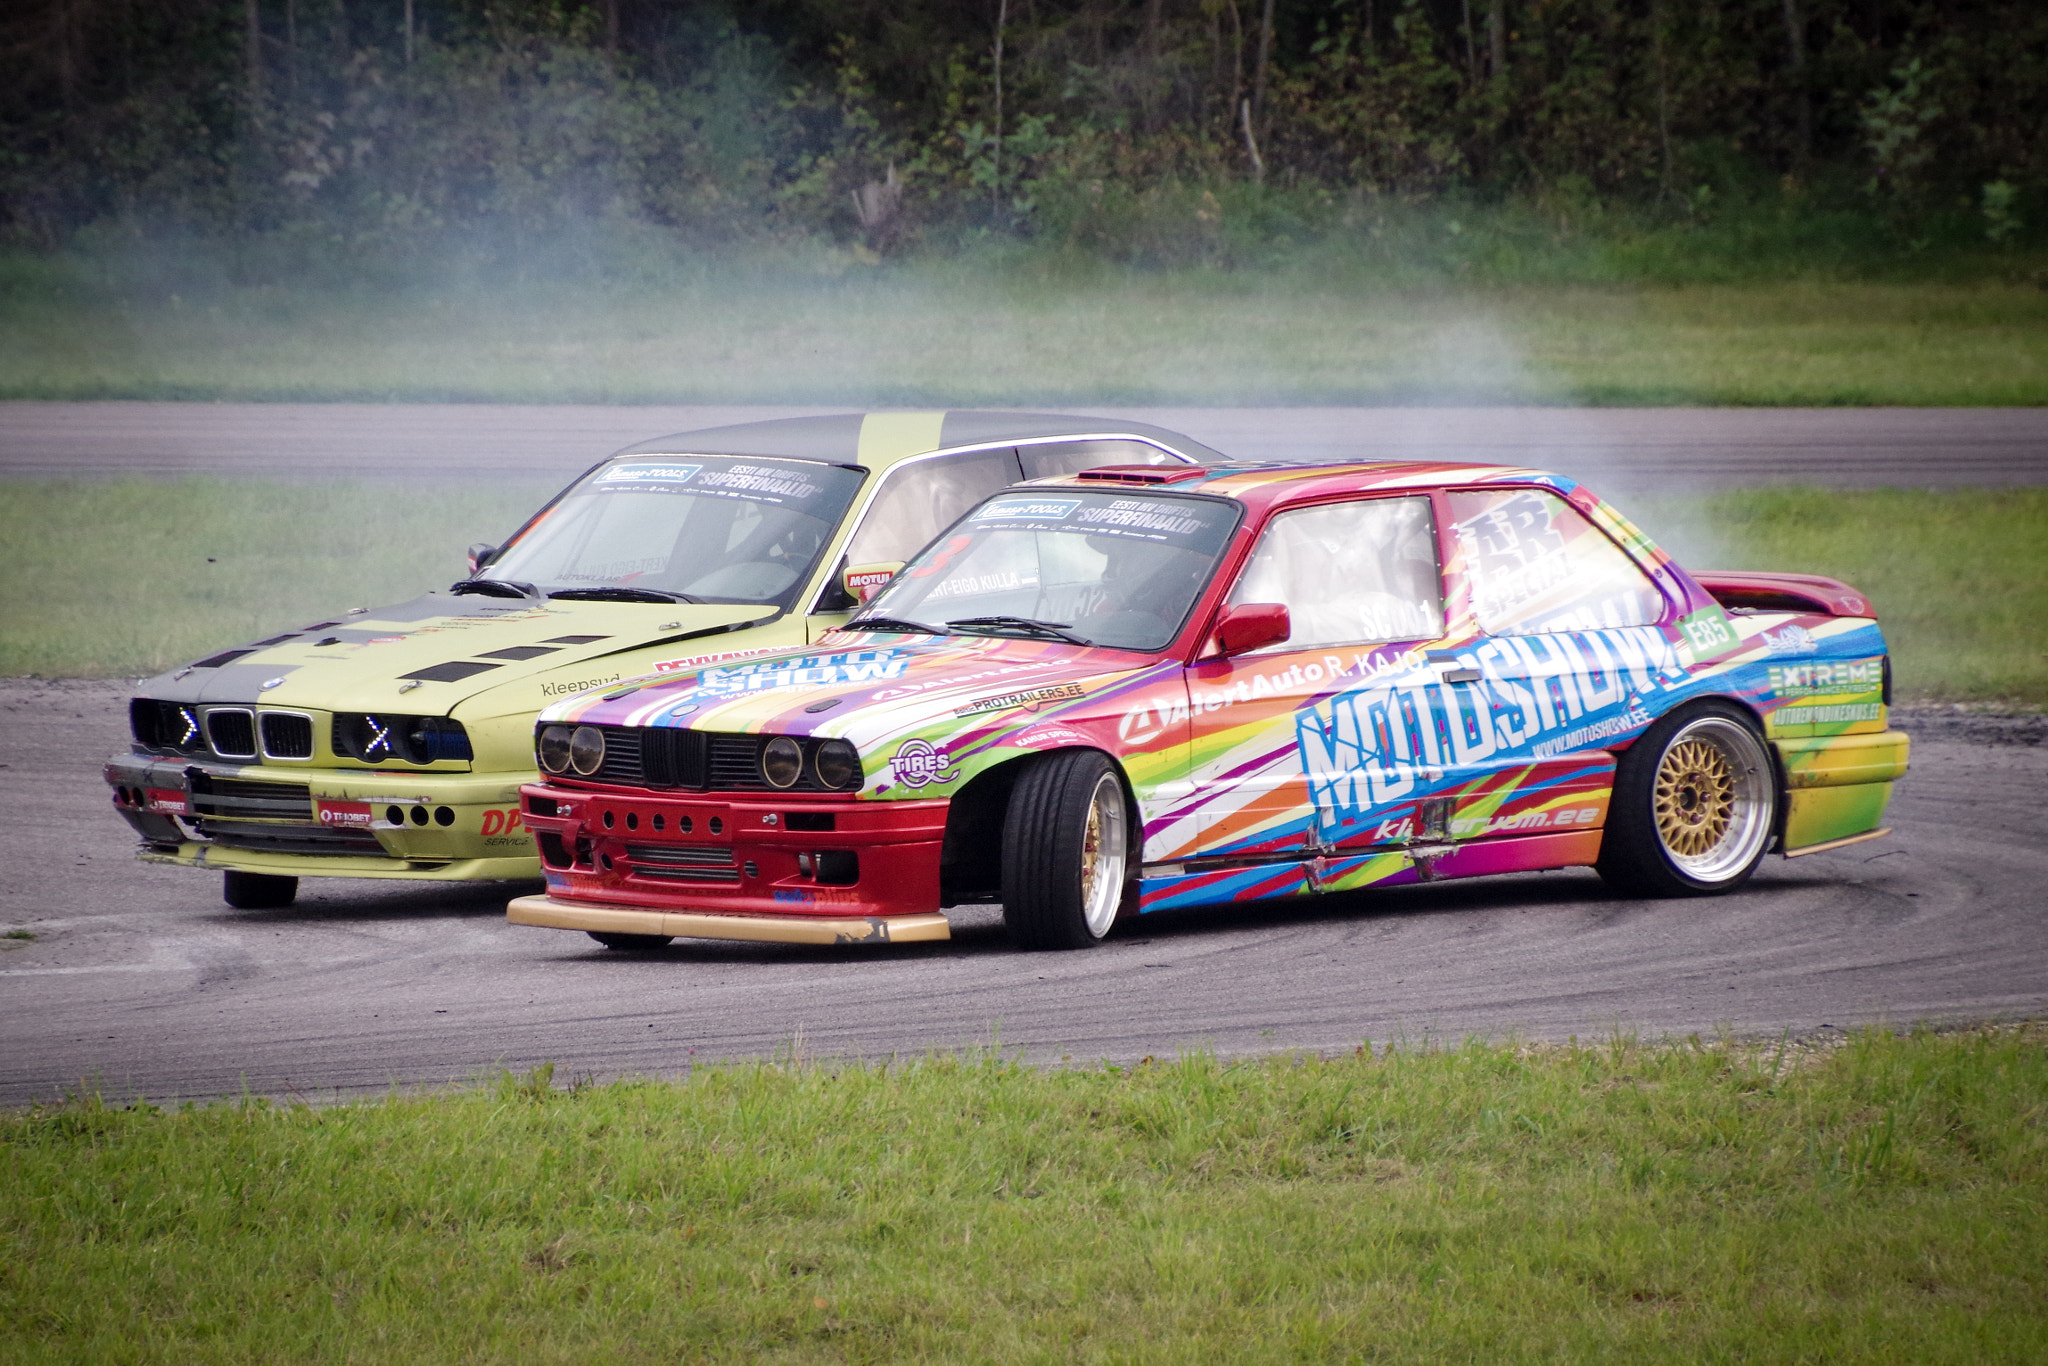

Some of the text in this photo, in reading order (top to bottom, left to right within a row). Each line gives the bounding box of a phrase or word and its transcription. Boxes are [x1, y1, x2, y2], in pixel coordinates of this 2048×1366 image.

[728, 464, 758, 475] EESTI
[1108, 499, 1141, 510] EESTI
[1154, 504, 1196, 518] DRIFTIS
[980, 571, 1019, 590] KULLA
[1684, 615, 1730, 651] E85
[1354, 649, 1424, 677] KAJO
[1768, 662, 1881, 688] EXTREME
[698, 661, 906, 696] SHOW
[973, 685, 1085, 711] PROTRAILERS.EE
[1300, 605, 1688, 828] MOTOSHOW
[1532, 707, 1654, 760] WWW.MOTOSHOW.EE
[889, 753, 950, 774] TIRES
[332, 812, 370, 822] TRIOBET
